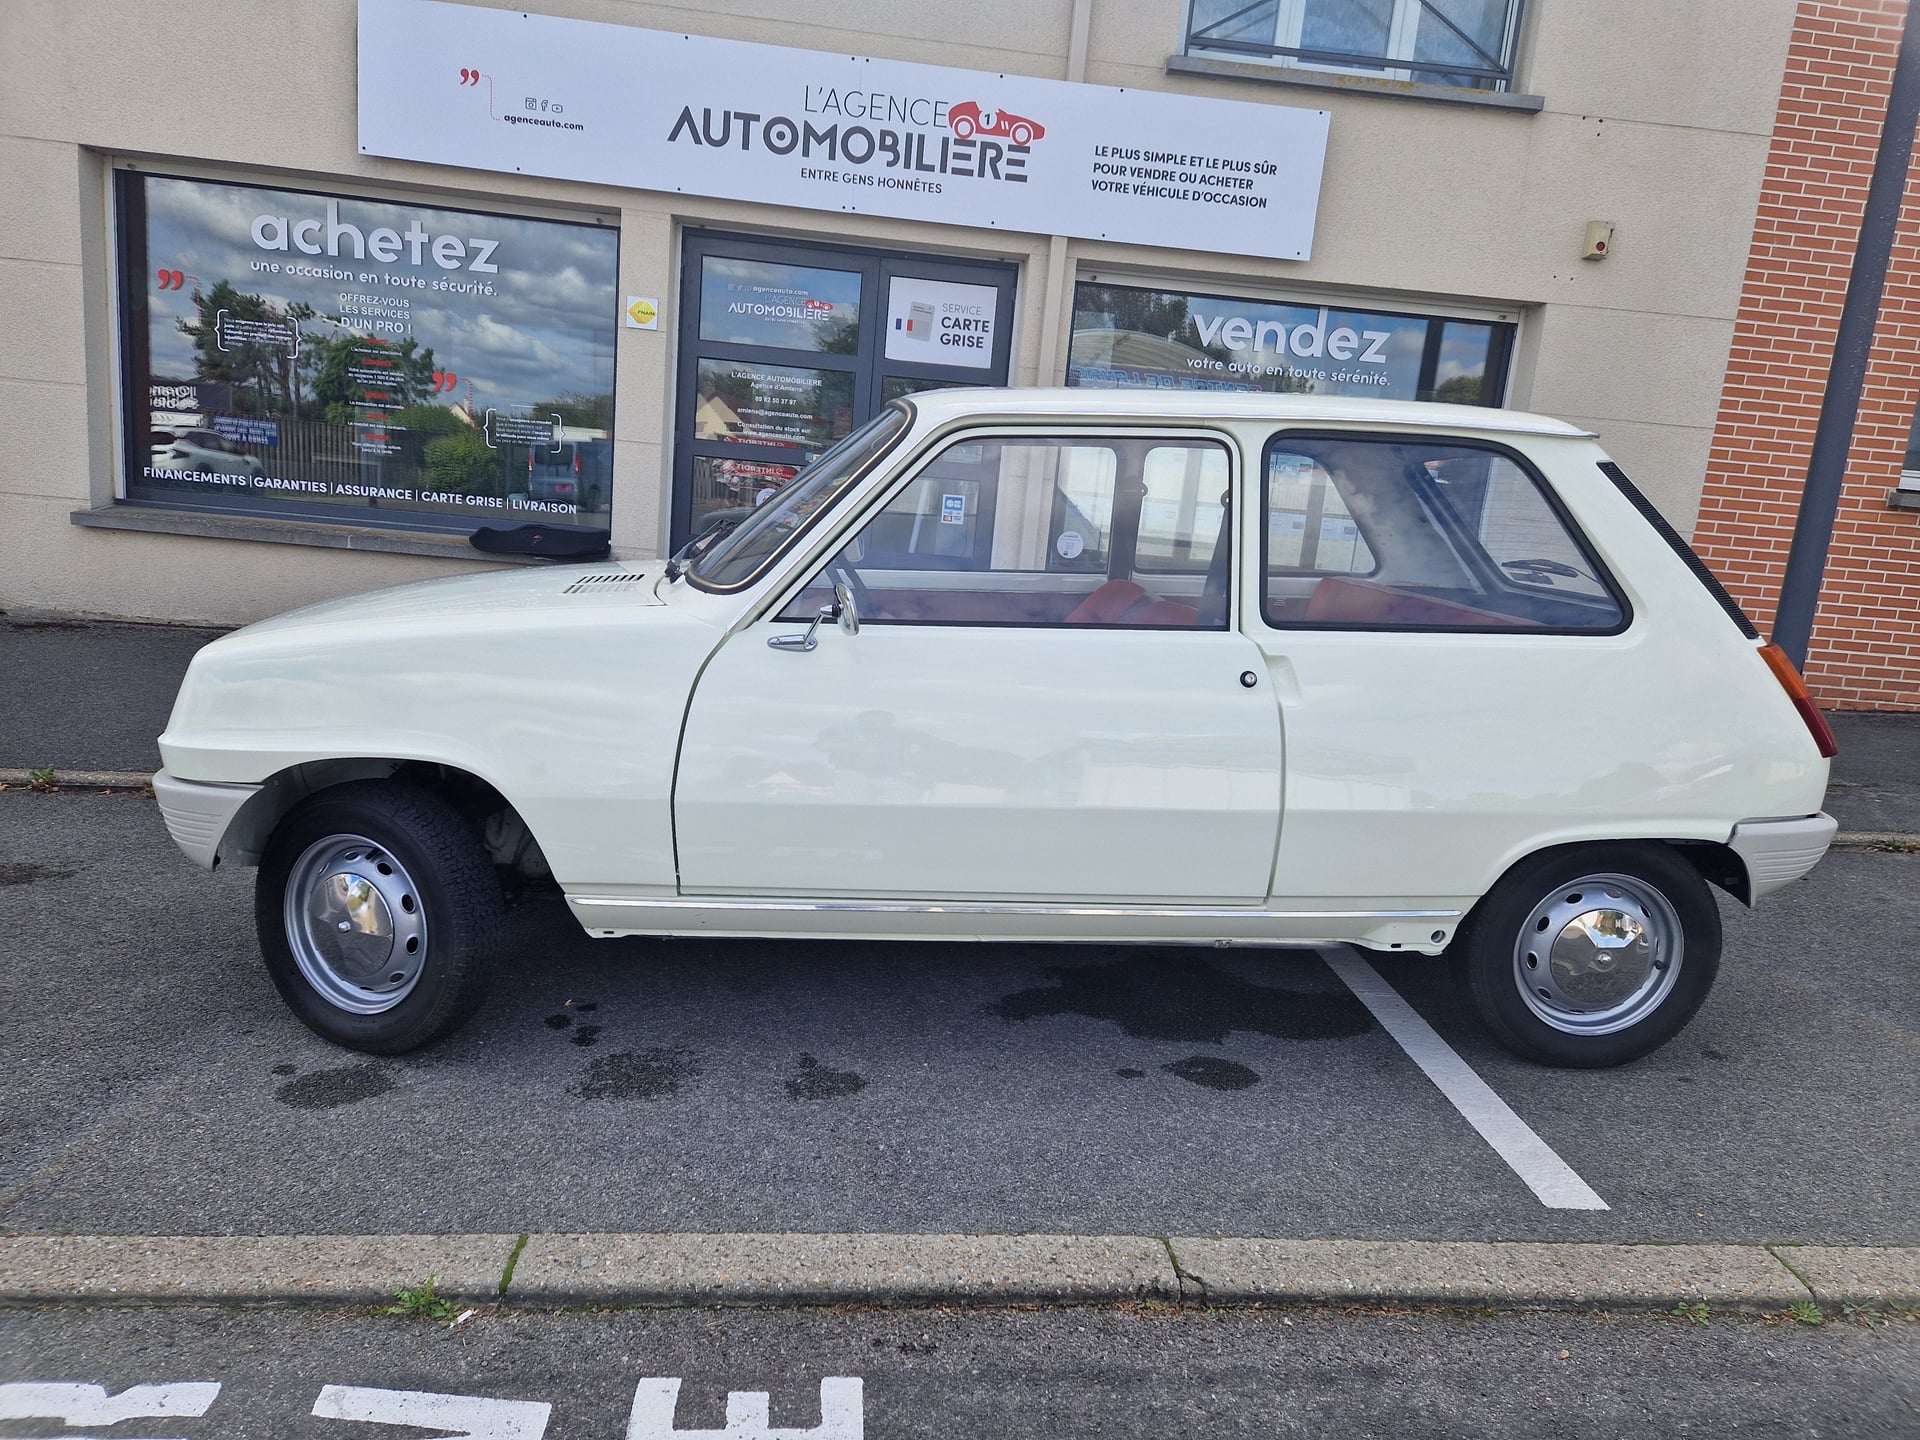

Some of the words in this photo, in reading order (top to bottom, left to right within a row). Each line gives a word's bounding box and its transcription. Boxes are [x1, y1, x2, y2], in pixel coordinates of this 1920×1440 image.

[803, 85, 949, 128] L'AGENCE
[504, 115, 584, 130] agenceauto.com
[1095, 145, 1109, 157] LE
[1111, 147, 1141, 161] PLUS
[1143, 151, 1187, 166] SIMPLE
[1189, 156, 1204, 167] ET
[1206, 158, 1219, 169] LE
[1222, 160, 1251, 172] PLUS
[1253, 160, 1278, 176] SÛR
[800, 167, 839, 182] ENTRE
[842, 172, 874, 187] GENS
[877, 177, 943, 194] HONNÊTES
[1093, 162, 1127, 176] POUR
[1130, 167, 1176, 182] VENDRE
[1178, 172, 1197, 184] OU
[1199, 174, 1254, 190] ACHETER
[1091, 179, 1130, 194] VOTRE
[1132, 182, 1189, 200] VÉHICULE
[1192, 191, 1267, 208] D'OCCASION
[251, 200, 500, 274] achetez
[250, 261, 280, 273] une
[285, 264, 354, 282] occasion
[359, 272, 378, 284] en
[384, 272, 427, 290] toute
[432, 276, 499, 296] sécurité.
[340, 292, 410, 308] OFFREZ-VOUS
[753, 286, 809, 296] agenceauto.com
[340, 304, 359, 314] LES
[361, 306, 410, 320] SERVICES
[942, 303, 982, 316] SERVICE
[341, 316, 372, 330] D'UN
[376, 320, 404, 333] PRO
[941, 316, 990, 332] CARTE
[1193, 306, 1391, 364] vendez
[940, 332, 984, 348] GRISE
[731, 371, 765, 381] L'AGENCE
[766, 375, 822, 386] AUTOMOBILIERE
[1186, 358, 1223, 371] votre
[1228, 362, 1260, 374] auto
[1266, 366, 1283, 376] en
[1288, 366, 1326, 380] toute
[1330, 368, 1391, 386] sérénité.
[750, 382, 772, 390] Agence
[144, 466, 246, 486] FINANCEMENTS
[254, 476, 327, 493] GARANTIES
[336, 484, 412, 500] ASSURANCE
[422, 491, 463, 505] CARTE
[466, 495, 503, 508] GRISE
[512, 500, 577, 514] LIVRAISON
